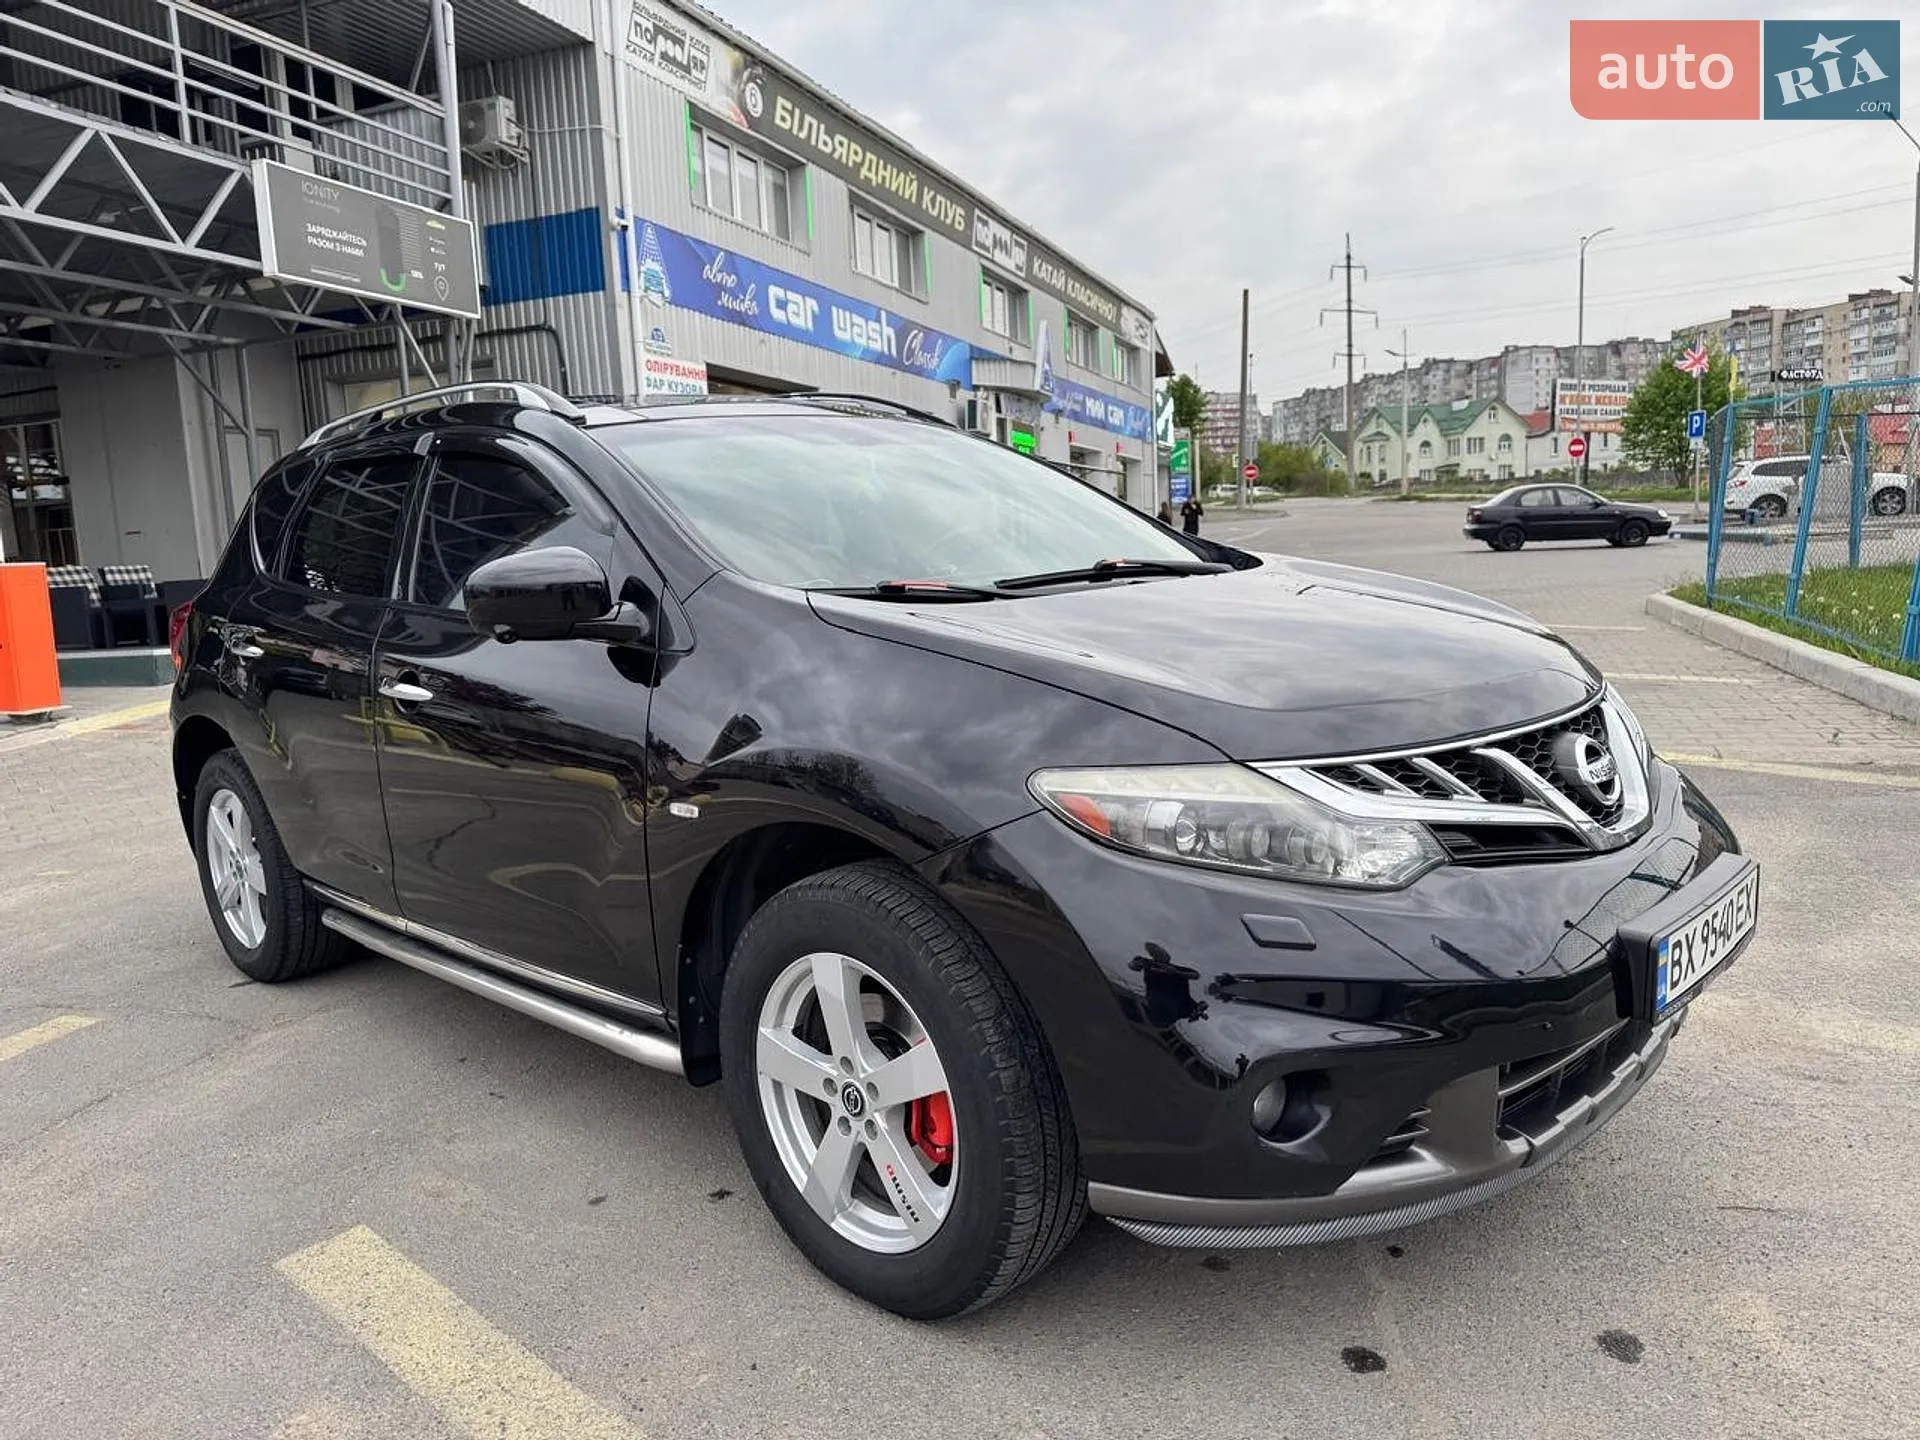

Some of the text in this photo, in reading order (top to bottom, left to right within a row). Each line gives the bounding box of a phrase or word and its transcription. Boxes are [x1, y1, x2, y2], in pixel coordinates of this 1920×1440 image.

[774, 95, 966, 232] БІЛЬЯРДНИЙ КЛУБ
[1033, 255, 1066, 292] КАТАЙ
[768, 284, 820, 332] car
[831, 305, 897, 358] wash
[1692, 415, 1700, 434] P
[1670, 878, 1754, 991] BX 9540 EX
